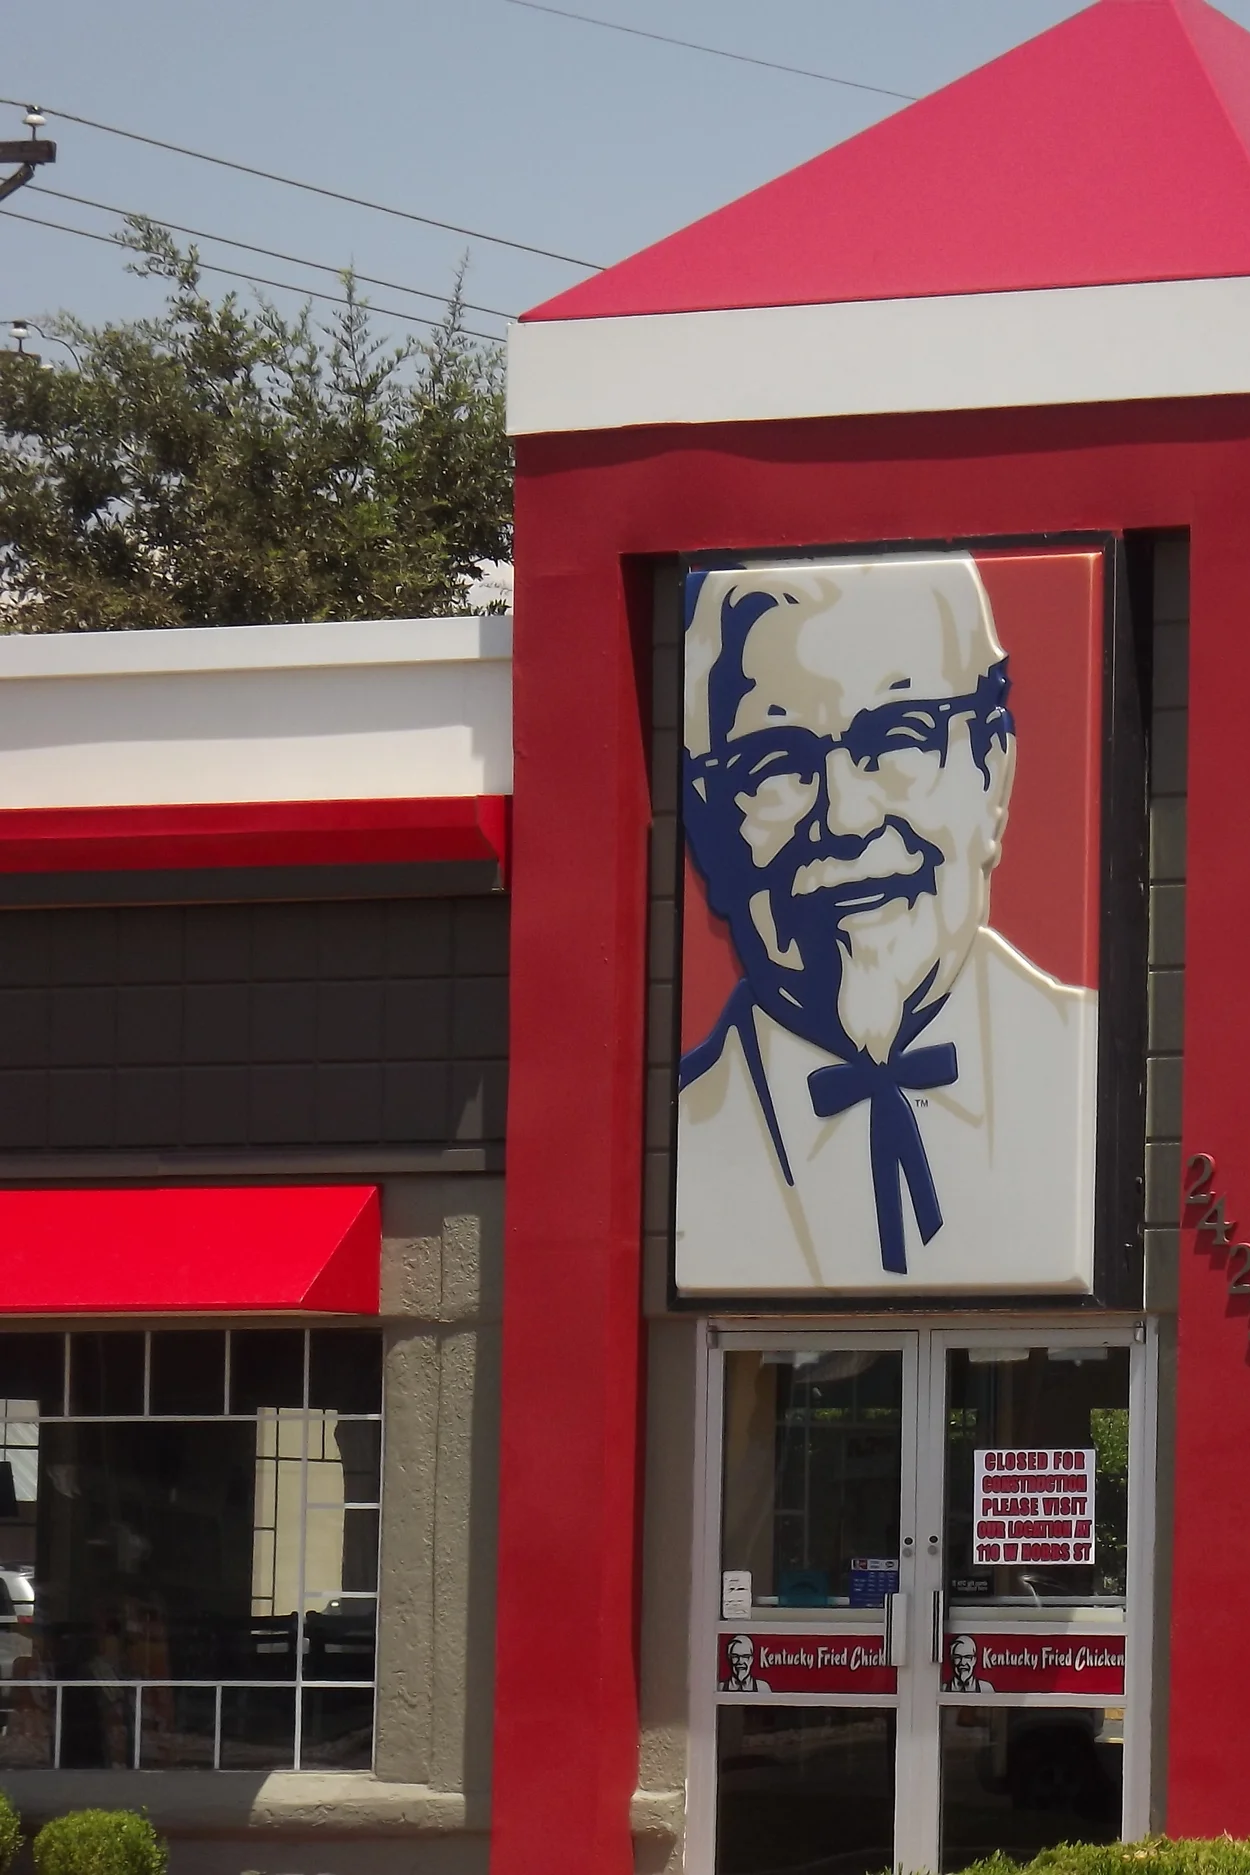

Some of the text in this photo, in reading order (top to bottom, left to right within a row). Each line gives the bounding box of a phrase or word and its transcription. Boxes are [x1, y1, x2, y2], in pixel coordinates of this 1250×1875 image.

[915, 1099, 929, 1108] TM
[984, 1451, 1086, 1471] CLOSED FOR
[982, 1474, 1088, 1493] CONSTRUCTION
[982, 1497, 1088, 1516] PLEASE VISIT
[977, 1520, 1093, 1539] OUR LOCATION AT
[976, 1543, 1001, 1562] 110
[1003, 1543, 1019, 1562] W
[1073, 1542, 1093, 1562] ST
[760, 1646, 814, 1669] Kentucky
[817, 1646, 848, 1669] Fried
[982, 1646, 1125, 1671] Kentucky Fried Chicken
